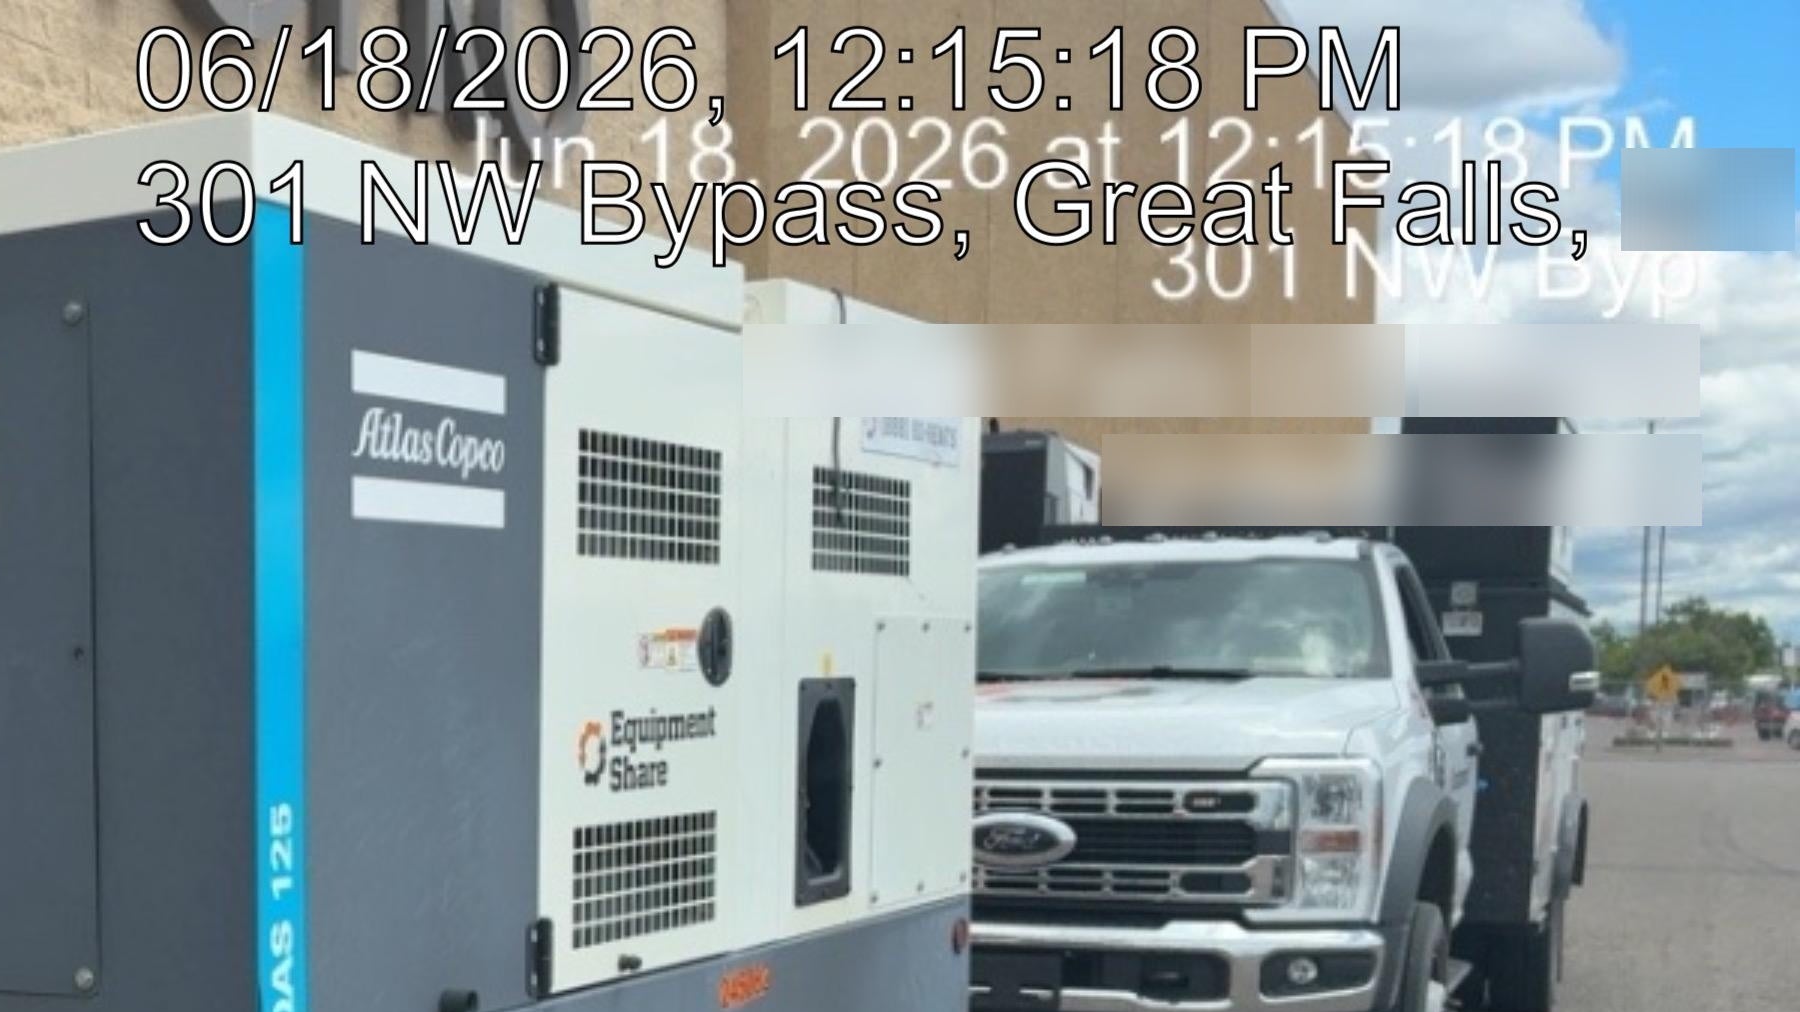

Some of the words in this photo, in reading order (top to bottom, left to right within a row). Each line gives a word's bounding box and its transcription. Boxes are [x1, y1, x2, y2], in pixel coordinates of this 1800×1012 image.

[351, 406, 432, 466] Atlas
[435, 416, 505, 481] Copco
[609, 704, 717, 753] Equipment
[609, 755, 668, 793] Share
[269, 801, 295, 901] 125
